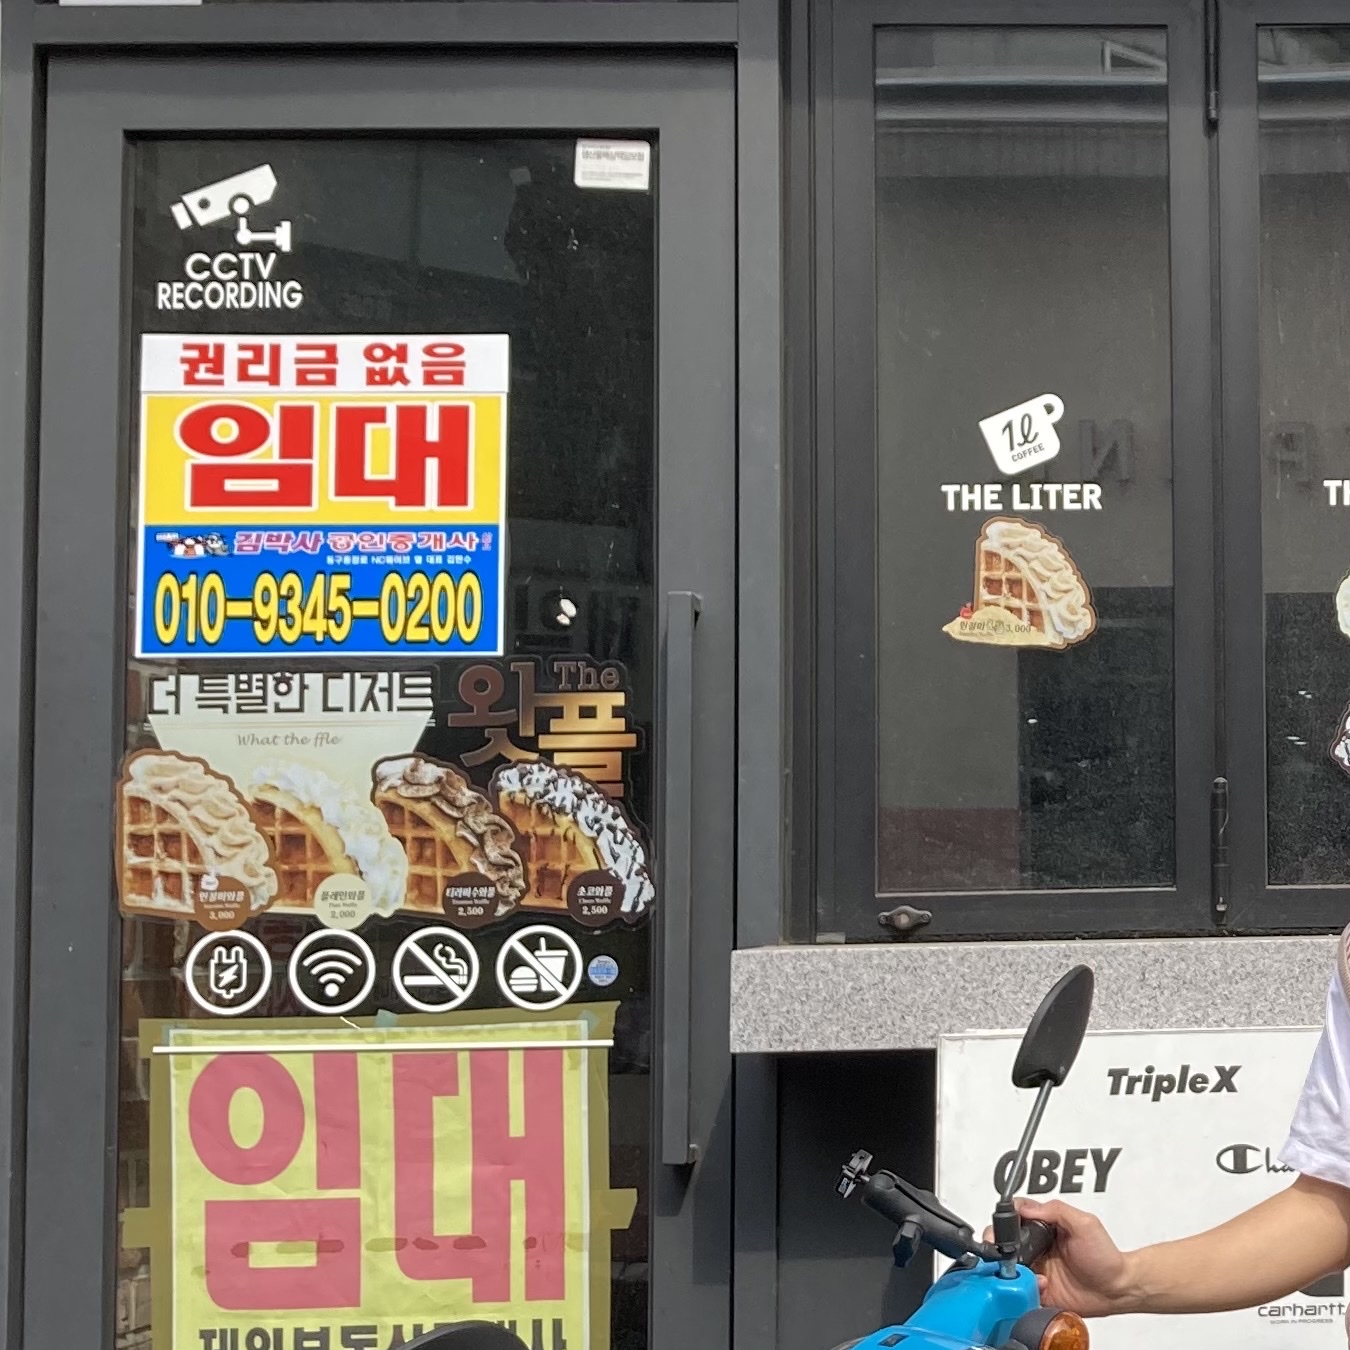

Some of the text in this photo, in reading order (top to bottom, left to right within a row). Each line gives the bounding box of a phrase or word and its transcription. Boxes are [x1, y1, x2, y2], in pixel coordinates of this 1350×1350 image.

[186, 252, 276, 280] CCTV
[157, 281, 303, 310] RECORDING
[180, 343, 465, 386] 권리금 없음
[177, 402, 471, 508] 임대
[1011, 442, 1045, 462] COFFEE
[941, 483, 1102, 511] THE LITER
[328, 531, 479, 554] 공인중개사
[154, 571, 484, 644] 010-9345-0200
[554, 661, 620, 690] The
[149, 671, 433, 715] 더 특별한 디저트
[237, 732, 277, 747] What
[284, 732, 310, 746] the
[209, 911, 235, 920] 3,000
[458, 906, 484, 916] 2,500
[582, 906, 608, 915] 2,500
[188, 1050, 566, 1311] 임대
[993, 1148, 1122, 1196] OBEY
[1257, 1303, 1345, 1317] carhartt
